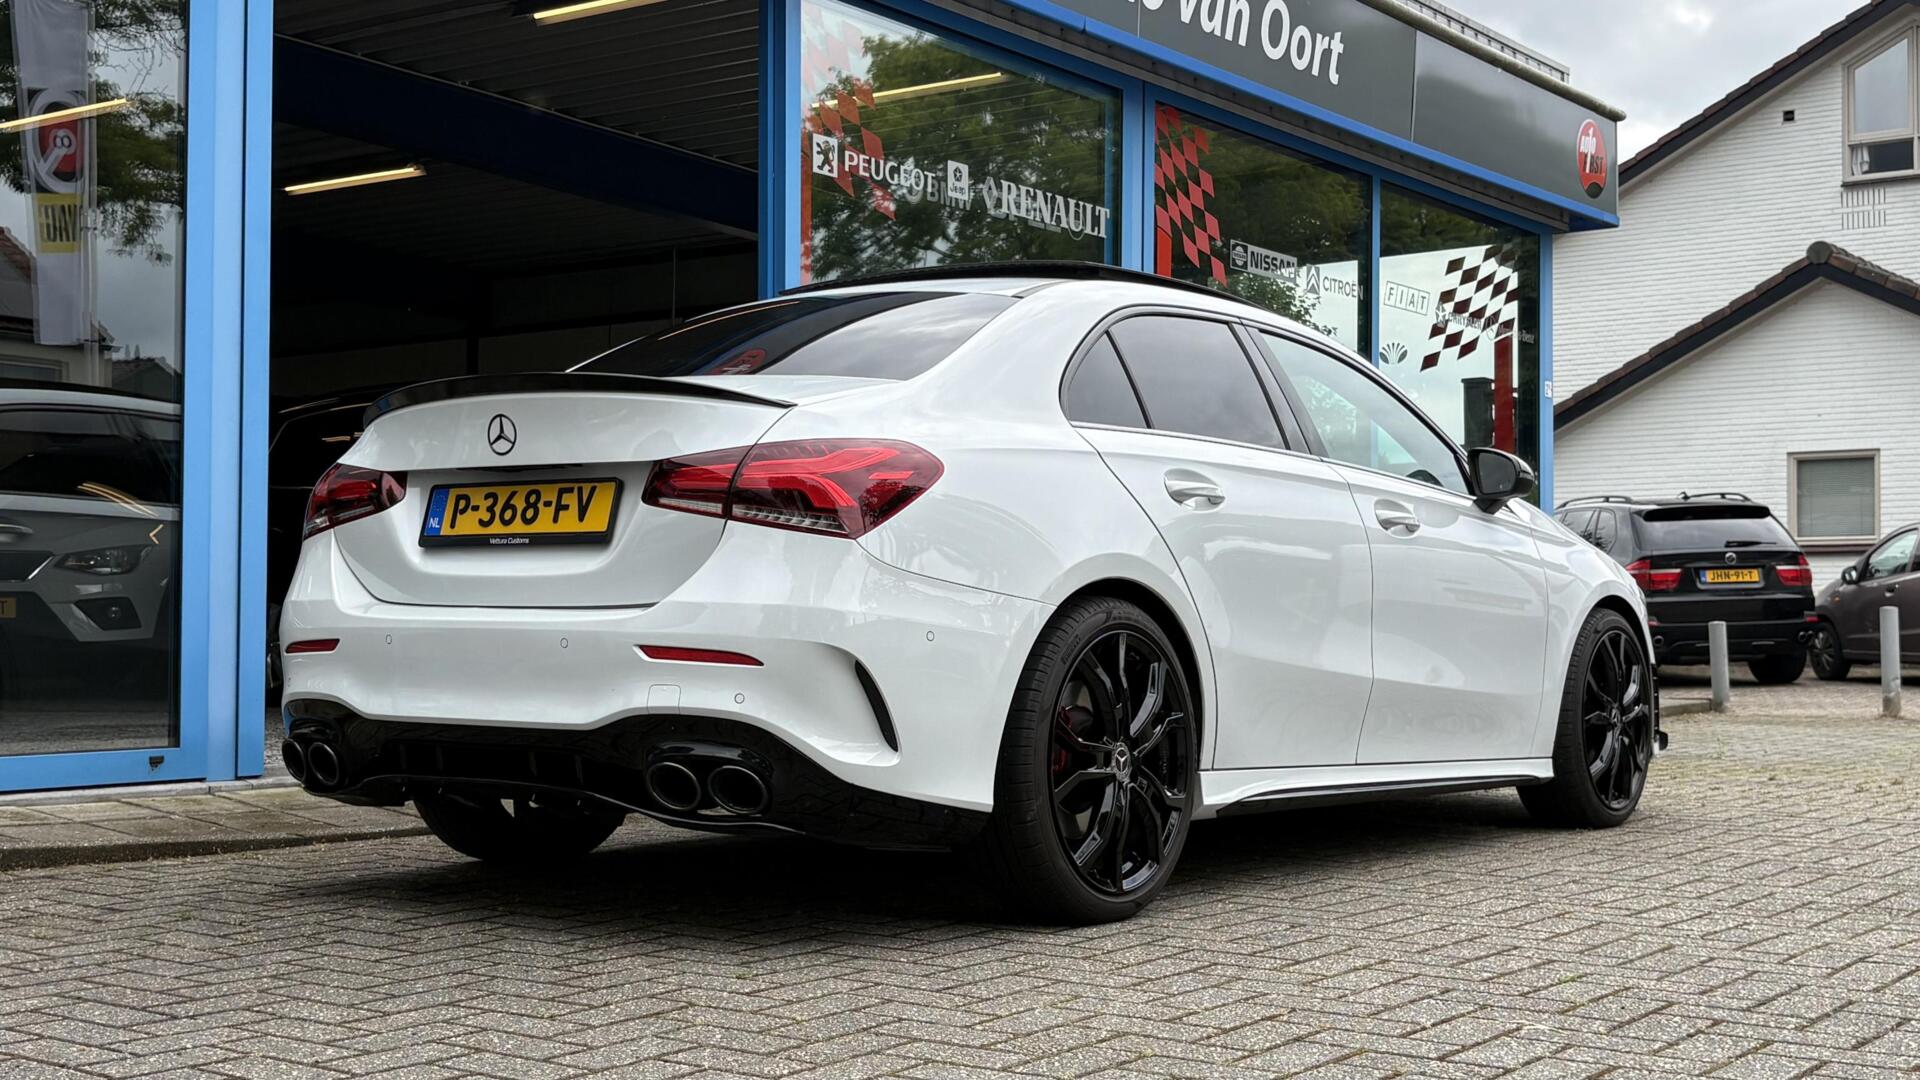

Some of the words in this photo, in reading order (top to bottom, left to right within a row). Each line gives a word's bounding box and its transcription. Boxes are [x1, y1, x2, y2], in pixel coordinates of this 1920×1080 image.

[1260, 0, 1344, 86] Oort
[844, 150, 936, 193] PEUGEOT
[949, 181, 966, 196] Jeep
[1000, 179, 1110, 239] RENAULT
[1250, 250, 1296, 279] NISSAN
[1322, 276, 1364, 301] CITROËN
[1386, 286, 1427, 314] FIAT
[428, 517, 440, 529] NL
[449, 485, 598, 530] P-368-FV
[1710, 570, 1754, 581] JHN-91-T
